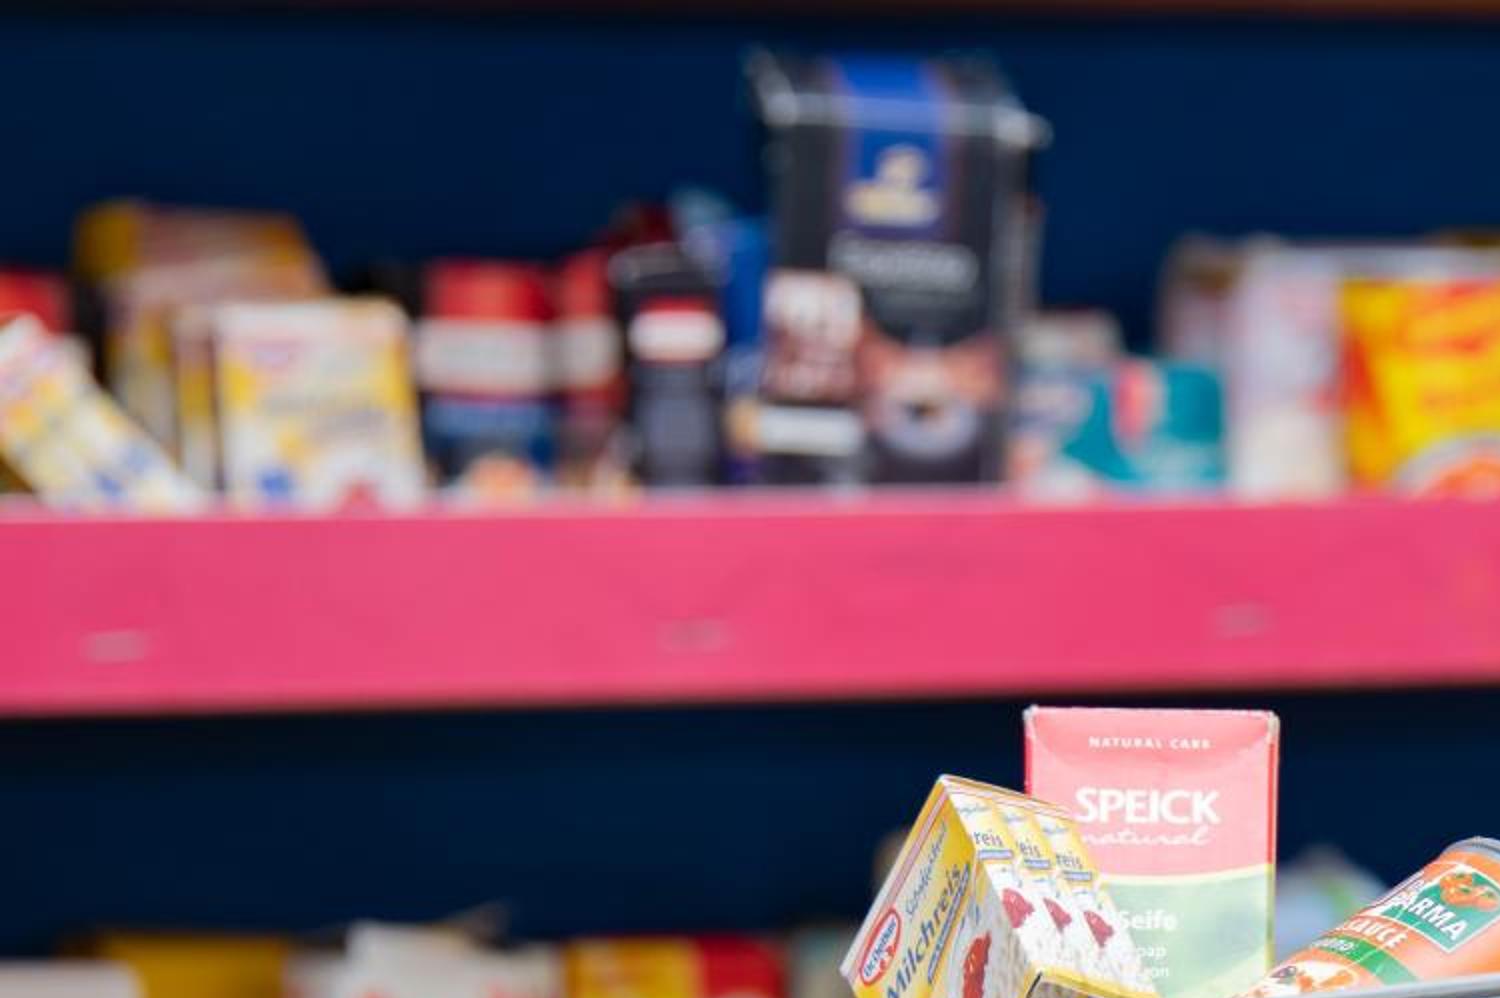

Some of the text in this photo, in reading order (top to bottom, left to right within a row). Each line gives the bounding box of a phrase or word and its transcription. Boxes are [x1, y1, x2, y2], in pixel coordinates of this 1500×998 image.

[1088, 736, 1211, 750] NATURAL CARE
[1075, 786, 1221, 824] SPEICK
[1118, 908, 1179, 932] Seife
[1136, 945, 1168, 961] oap
